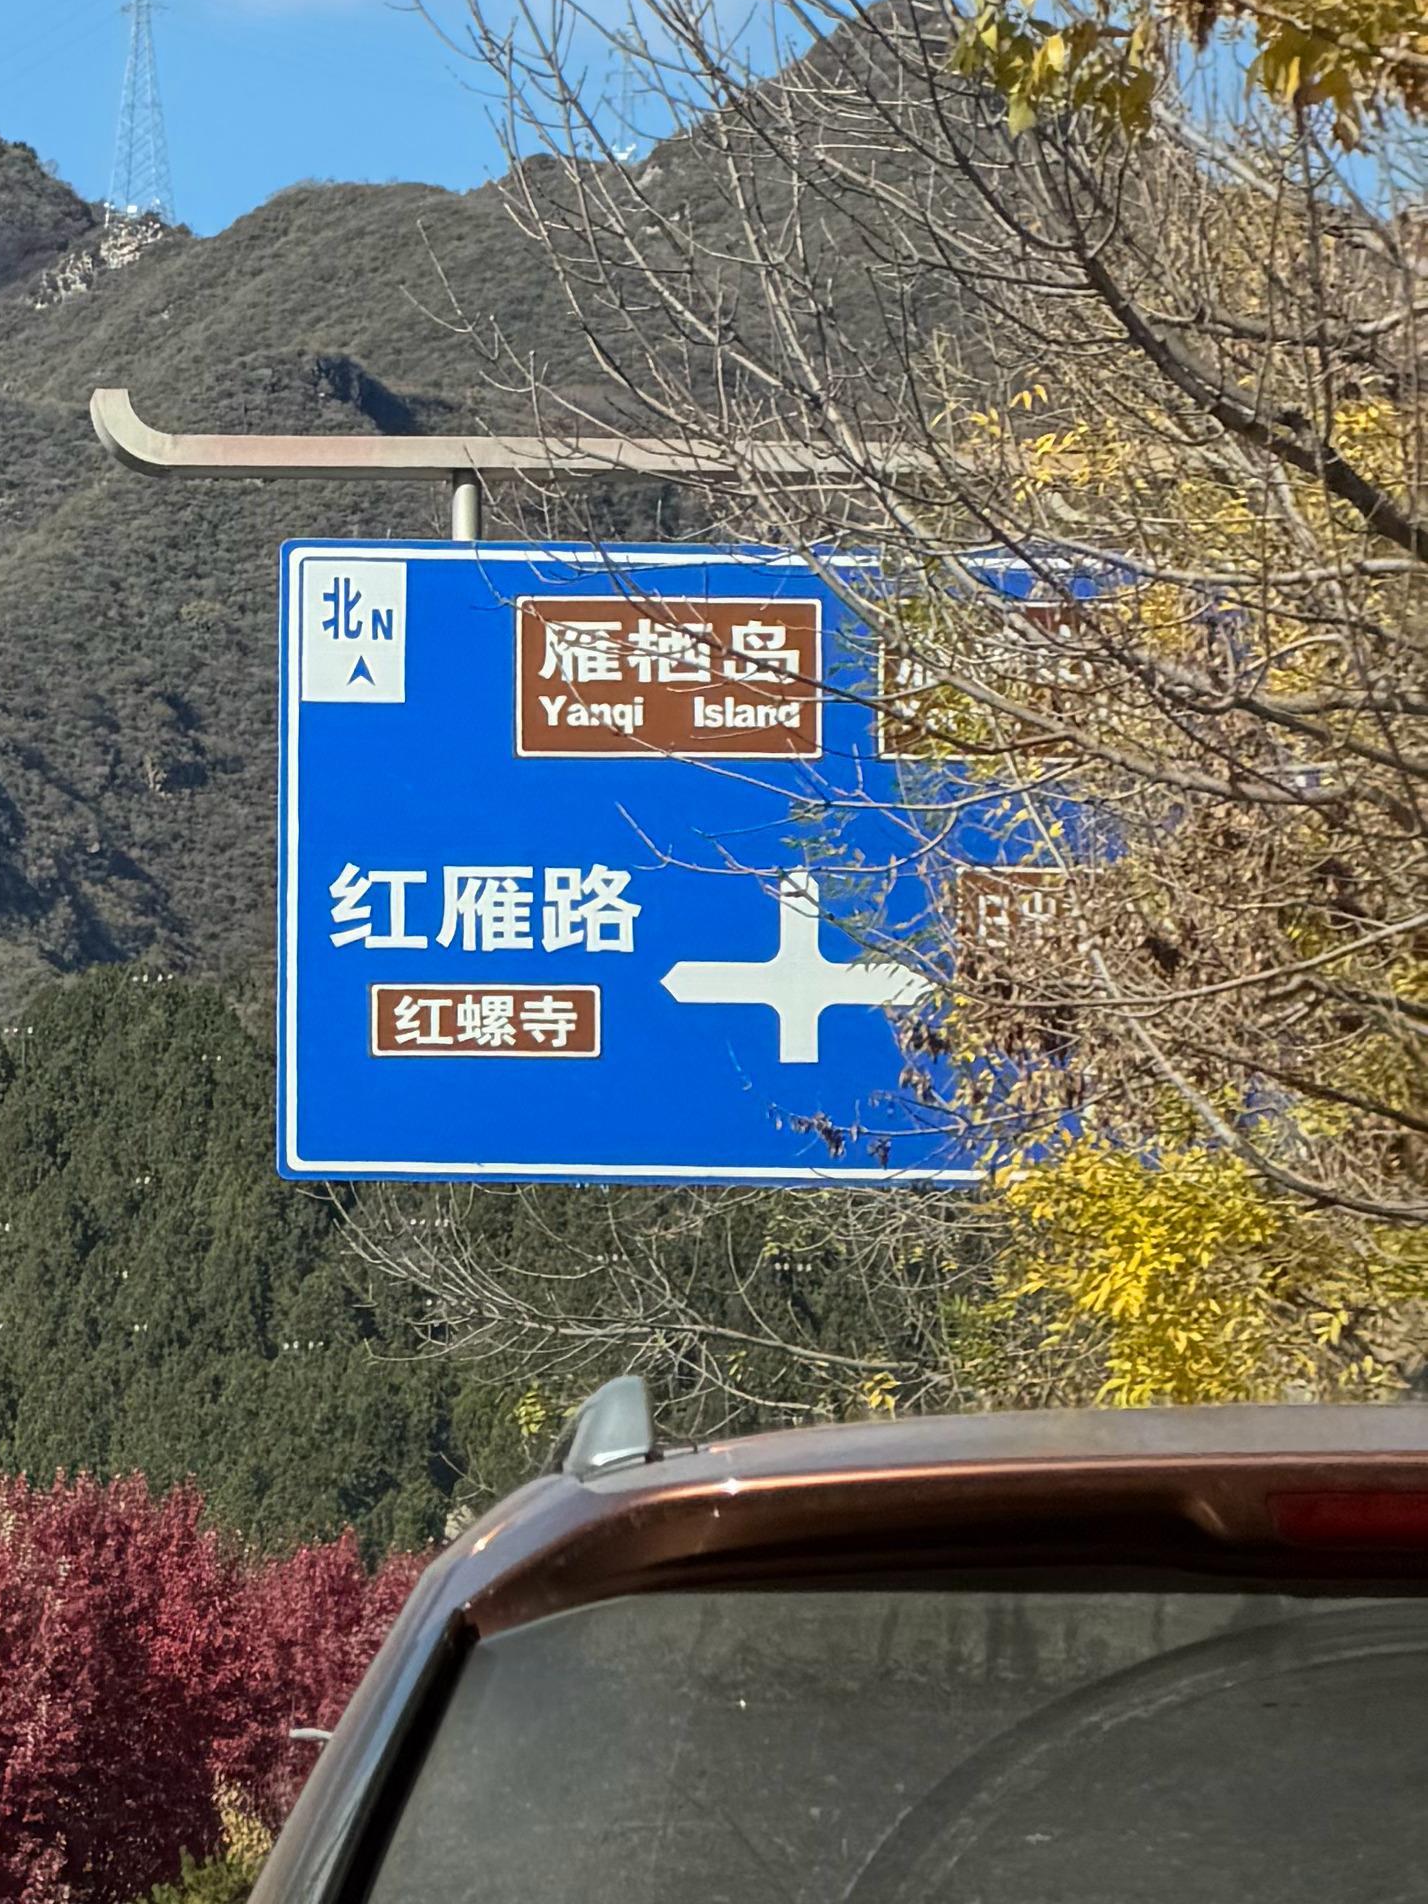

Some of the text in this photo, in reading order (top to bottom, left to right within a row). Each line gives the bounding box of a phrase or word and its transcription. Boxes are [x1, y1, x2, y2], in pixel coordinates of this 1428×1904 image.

[322, 576, 363, 640] 北
[371, 608, 393, 641] N
[538, 618, 801, 684] 雁栖岛
[538, 695, 801, 734] Yanqi Island
[328, 862, 642, 953] 红雁路
[393, 994, 578, 1048] 红螺寺
